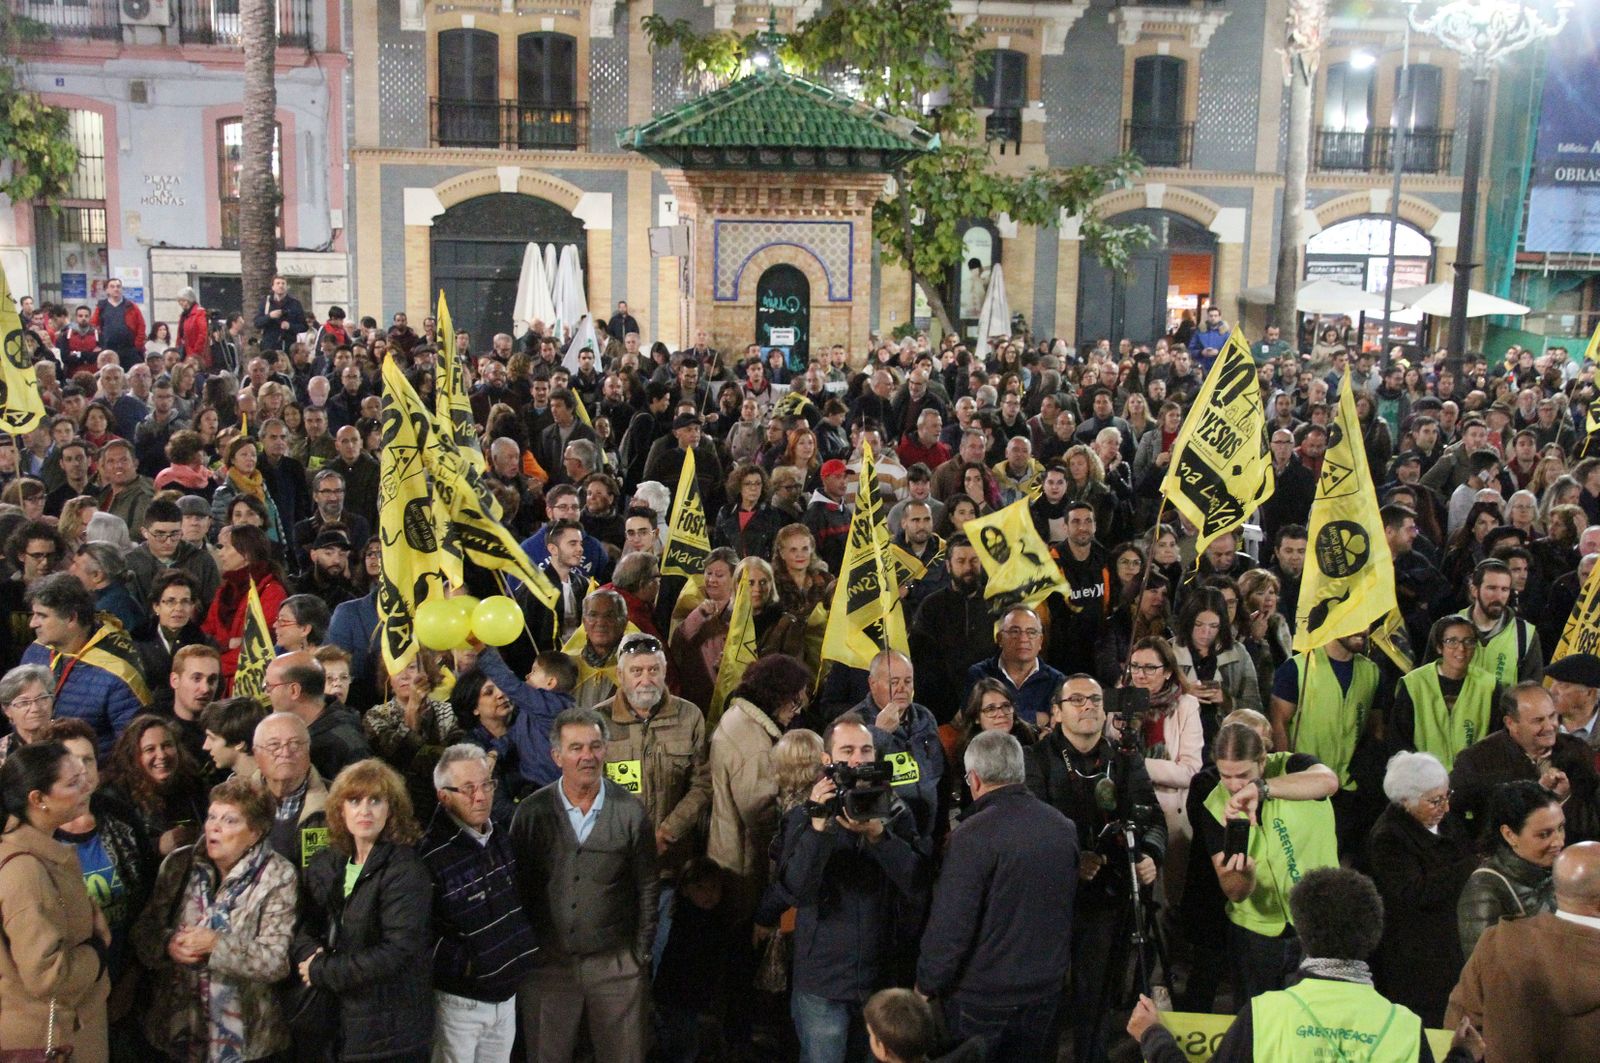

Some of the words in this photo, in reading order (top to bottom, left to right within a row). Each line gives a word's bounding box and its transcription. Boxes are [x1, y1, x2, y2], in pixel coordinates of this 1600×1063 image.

[144, 175, 181, 185] PLAZA
[140, 196, 184, 206] MONJAS
[152, 190, 173, 198] LAS
[1197, 408, 1243, 460] YESOS
[1062, 749, 1072, 772] LUMIX
[1296, 1025, 1378, 1045] GREENPEACE
